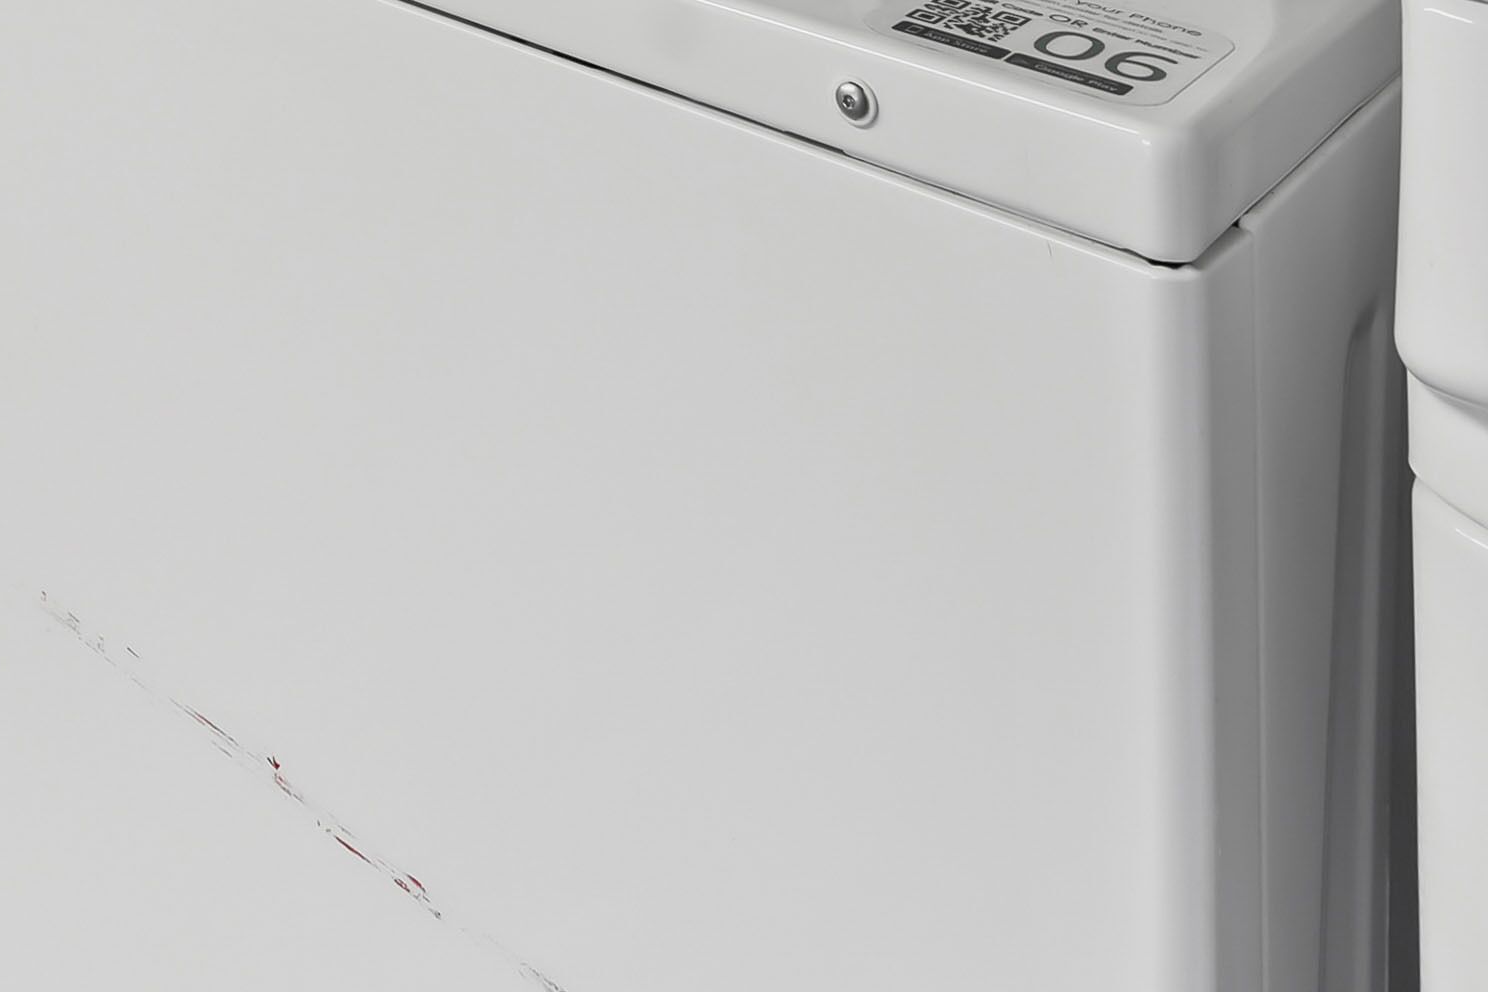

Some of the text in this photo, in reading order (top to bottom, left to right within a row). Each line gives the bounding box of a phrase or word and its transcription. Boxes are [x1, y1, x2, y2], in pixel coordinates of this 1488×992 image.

[1049, 14, 1089, 27] OR
[1135, 39, 1200, 58] Number
[1076, 0, 1125, 15] your
[1129, 13, 1202, 36] Phone
[1034, 31, 1178, 82] 06
